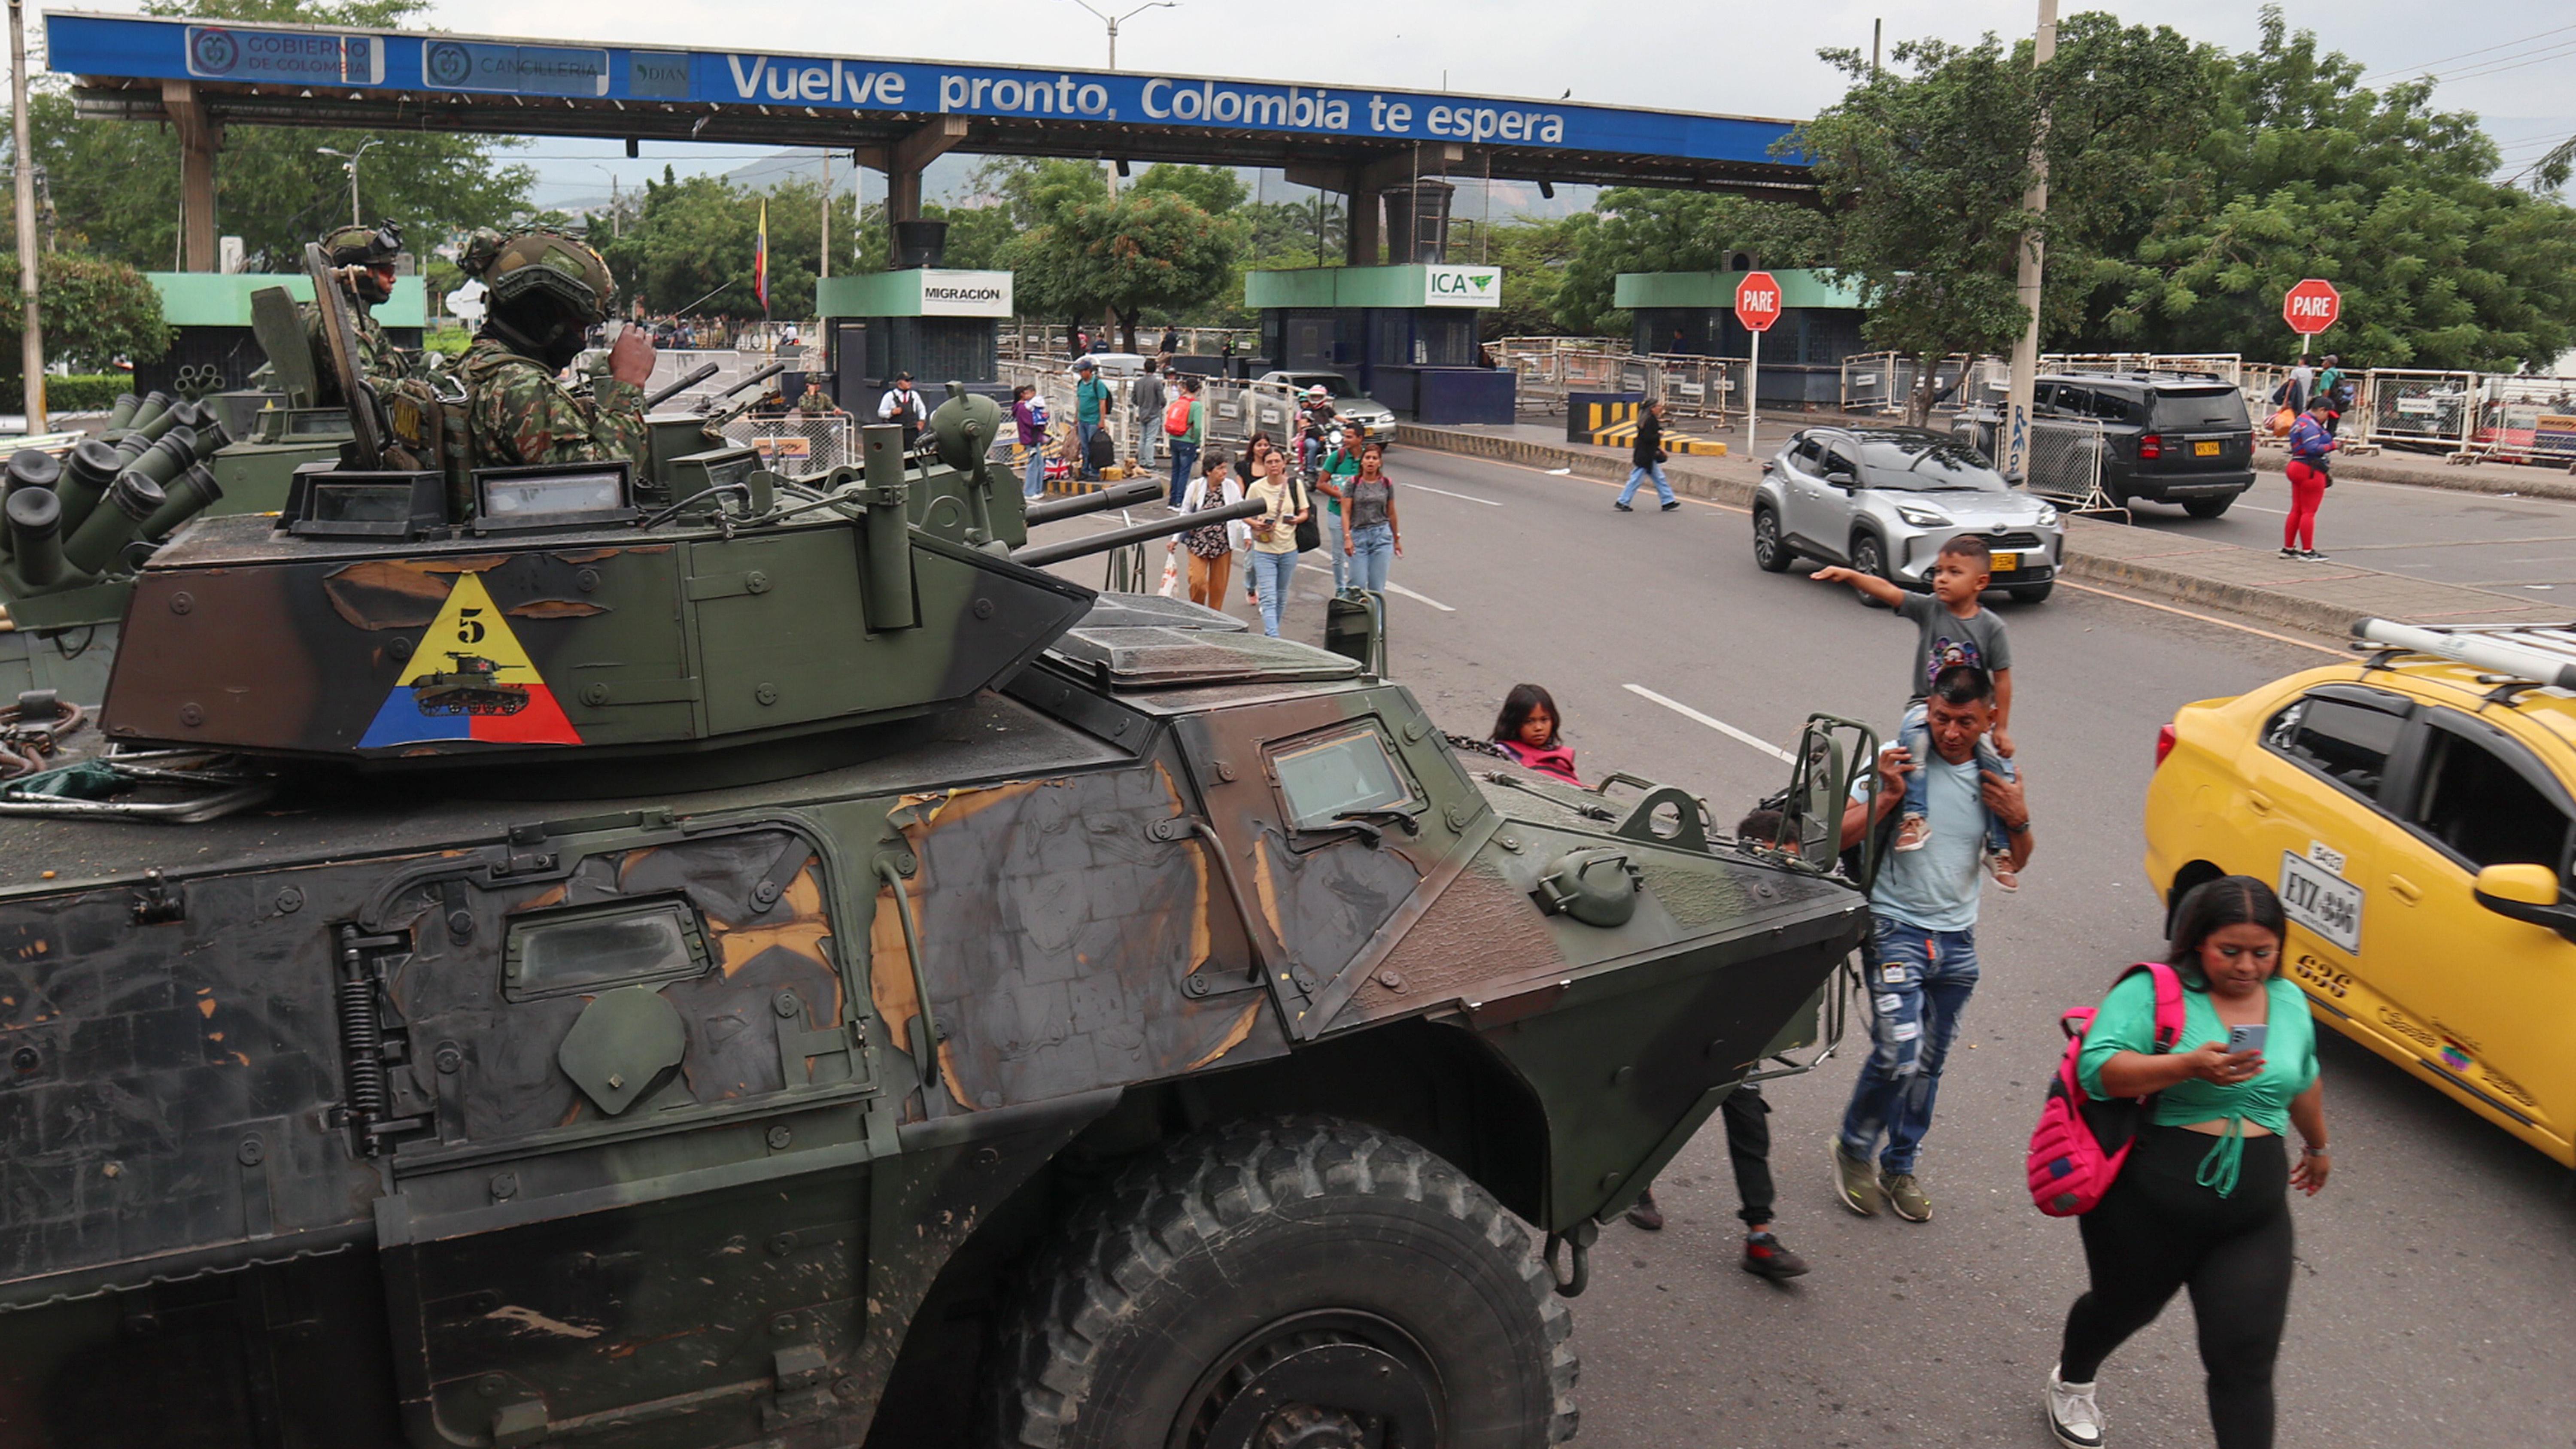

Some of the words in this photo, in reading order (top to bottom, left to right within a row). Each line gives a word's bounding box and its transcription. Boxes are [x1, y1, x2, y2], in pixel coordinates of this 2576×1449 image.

[248, 36, 367, 58] GOBIERNO
[249, 57, 271, 70] DE
[276, 59, 366, 74] COLOMBIA
[647, 67, 687, 82] DIAN
[727, 54, 905, 104] Vuelve
[939, 74, 1116, 121] pronto,
[1140, 78, 1349, 130] Colombia
[1369, 94, 1412, 132] te
[1427, 104, 1564, 144] espera
[925, 287, 1000, 300] MIGRACIÓN
[1431, 273, 1467, 293] ICA
[1743, 290, 1775, 313] PARE
[2292, 295, 2332, 317] PARE
[457, 608, 486, 644] 5
